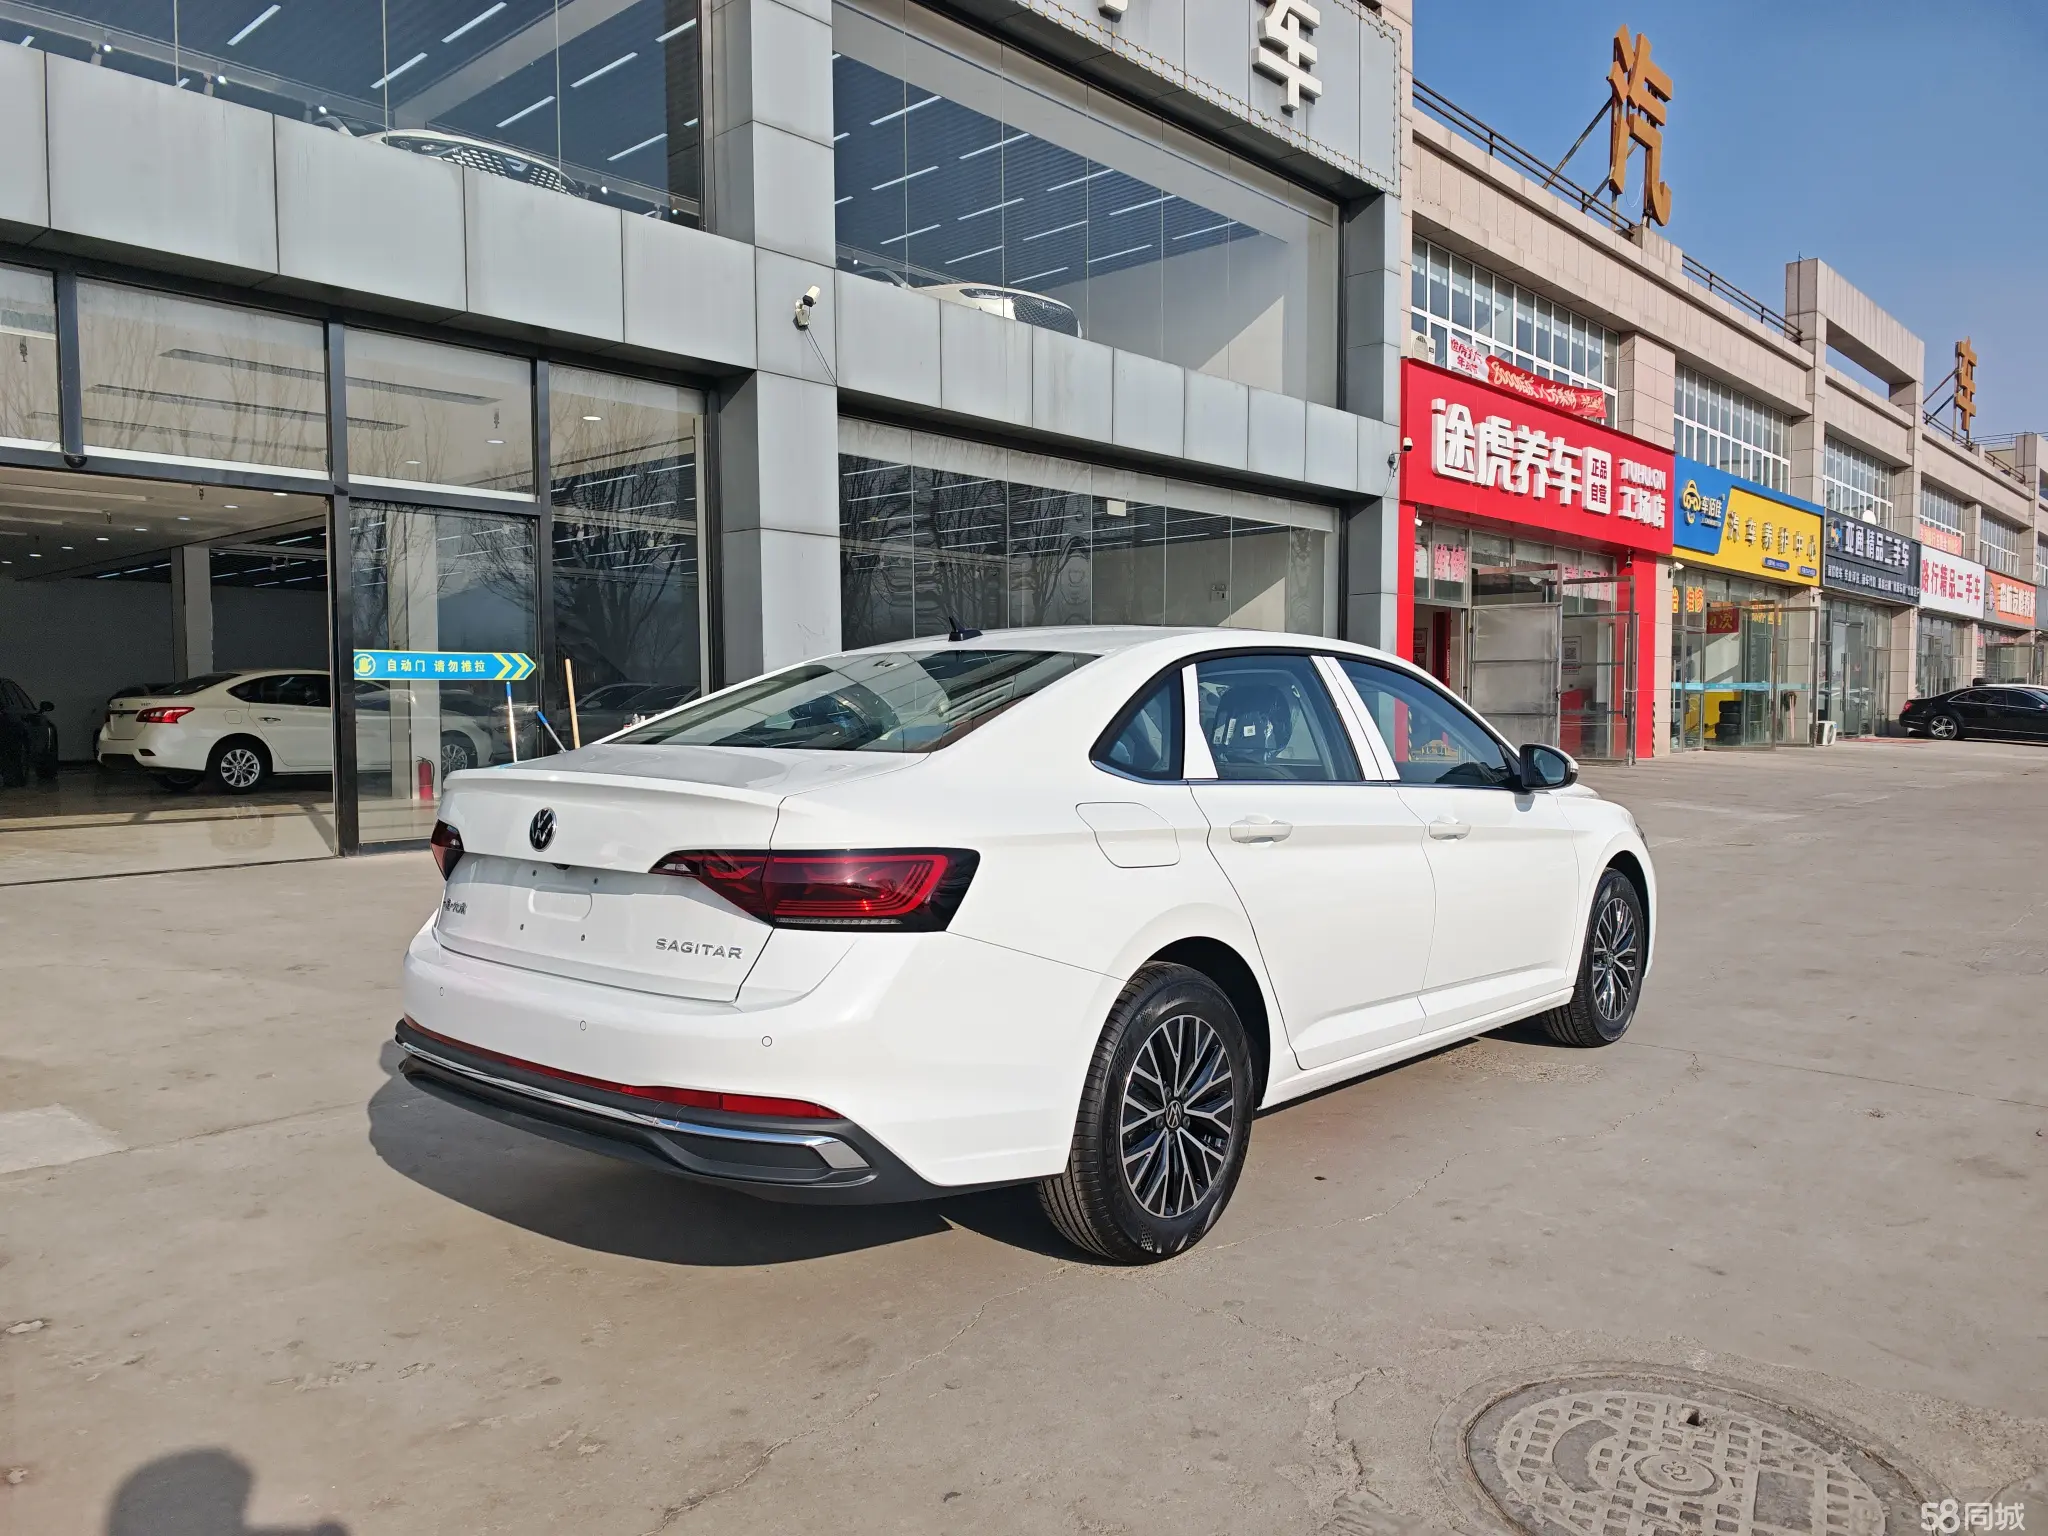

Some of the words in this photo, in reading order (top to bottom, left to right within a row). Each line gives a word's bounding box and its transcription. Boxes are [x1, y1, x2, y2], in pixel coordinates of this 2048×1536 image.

[1606, 24, 1674, 227] 汽
[1431, 398, 1583, 506] 途虎养车
[1590, 456, 1608, 480] 正品
[1590, 482, 1608, 505] 自营
[1618, 486, 1666, 529] 工场店
[387, 658, 426, 672] 自动门
[434, 660, 486, 673] 请勿推拉
[655, 937, 743, 961] SAGITAR
